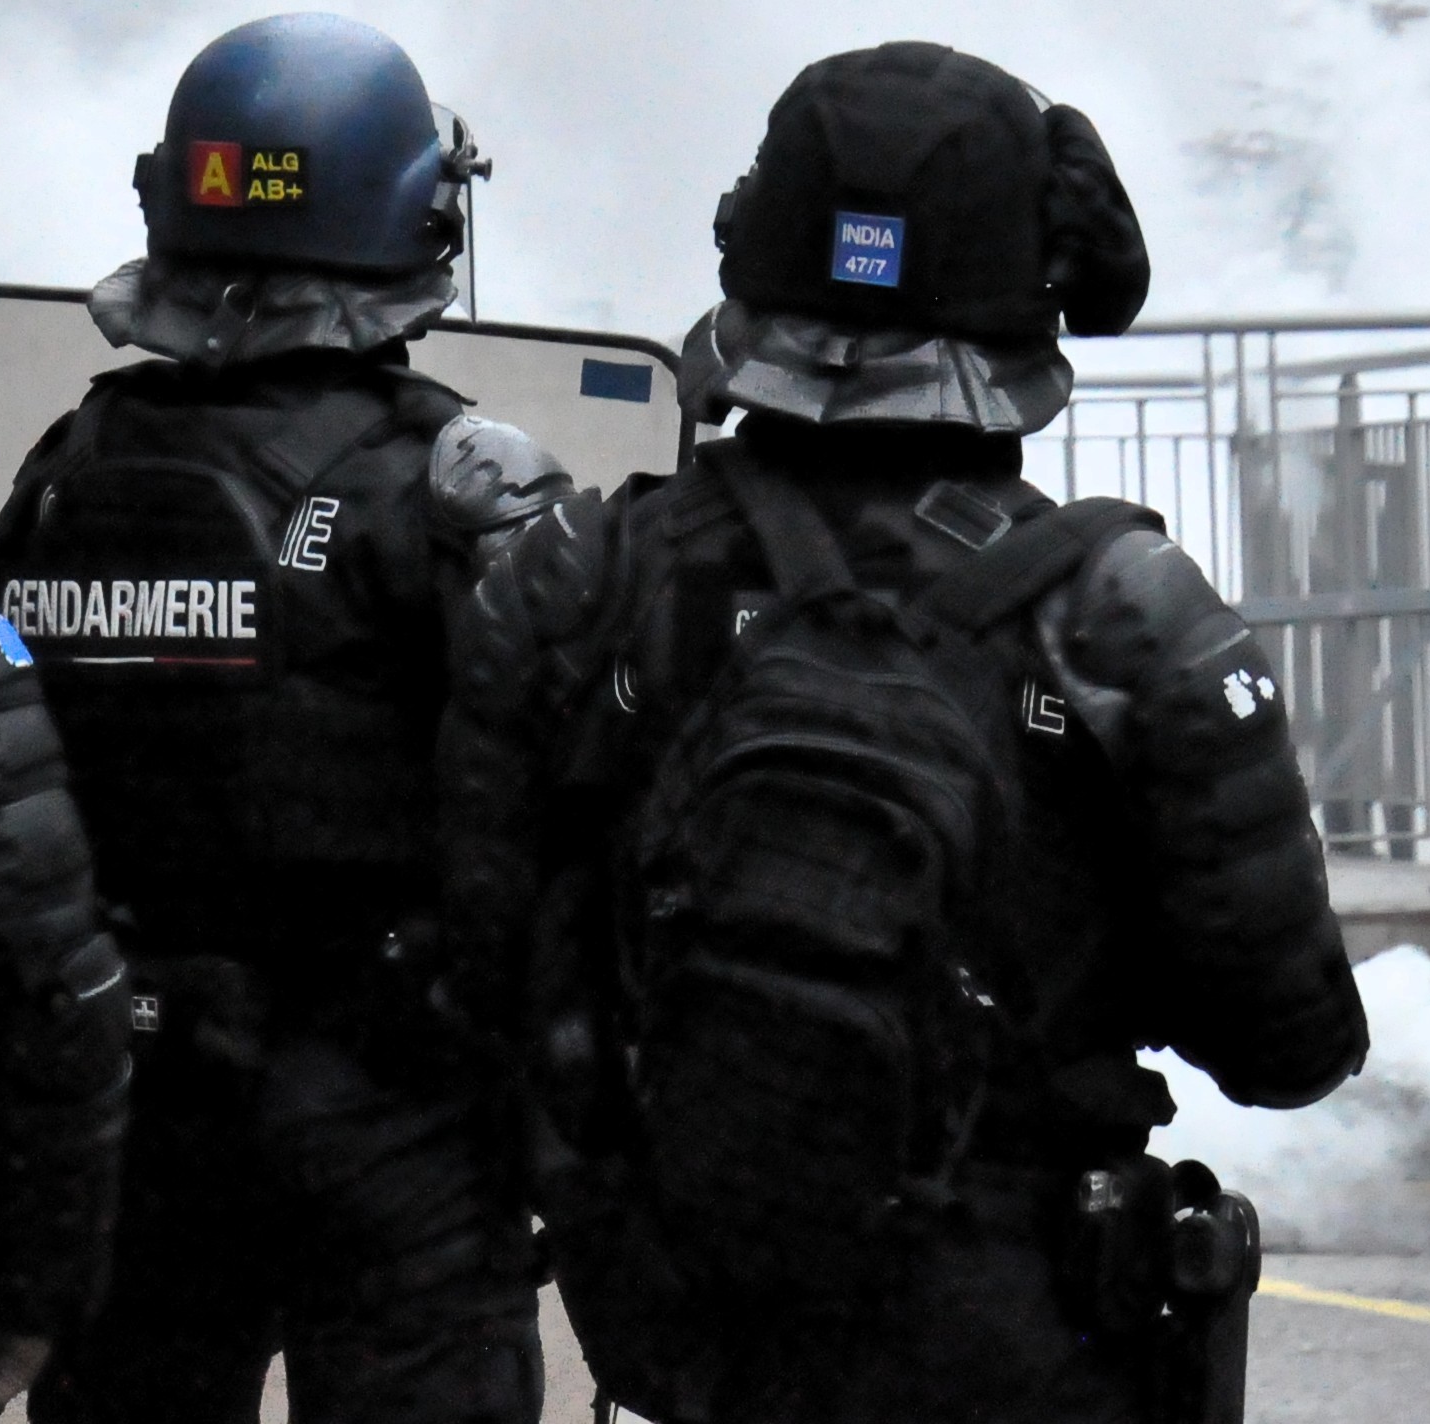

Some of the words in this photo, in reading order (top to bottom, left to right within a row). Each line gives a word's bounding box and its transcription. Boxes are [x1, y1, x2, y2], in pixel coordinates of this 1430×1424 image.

[252, 152, 299, 171] ALG
[200, 152, 231, 196] A
[248, 179, 303, 199] AB+
[842, 223, 894, 249] INDIA
[845, 256, 887, 276] 47/7
[3, 579, 257, 639] GENDARMERIE
